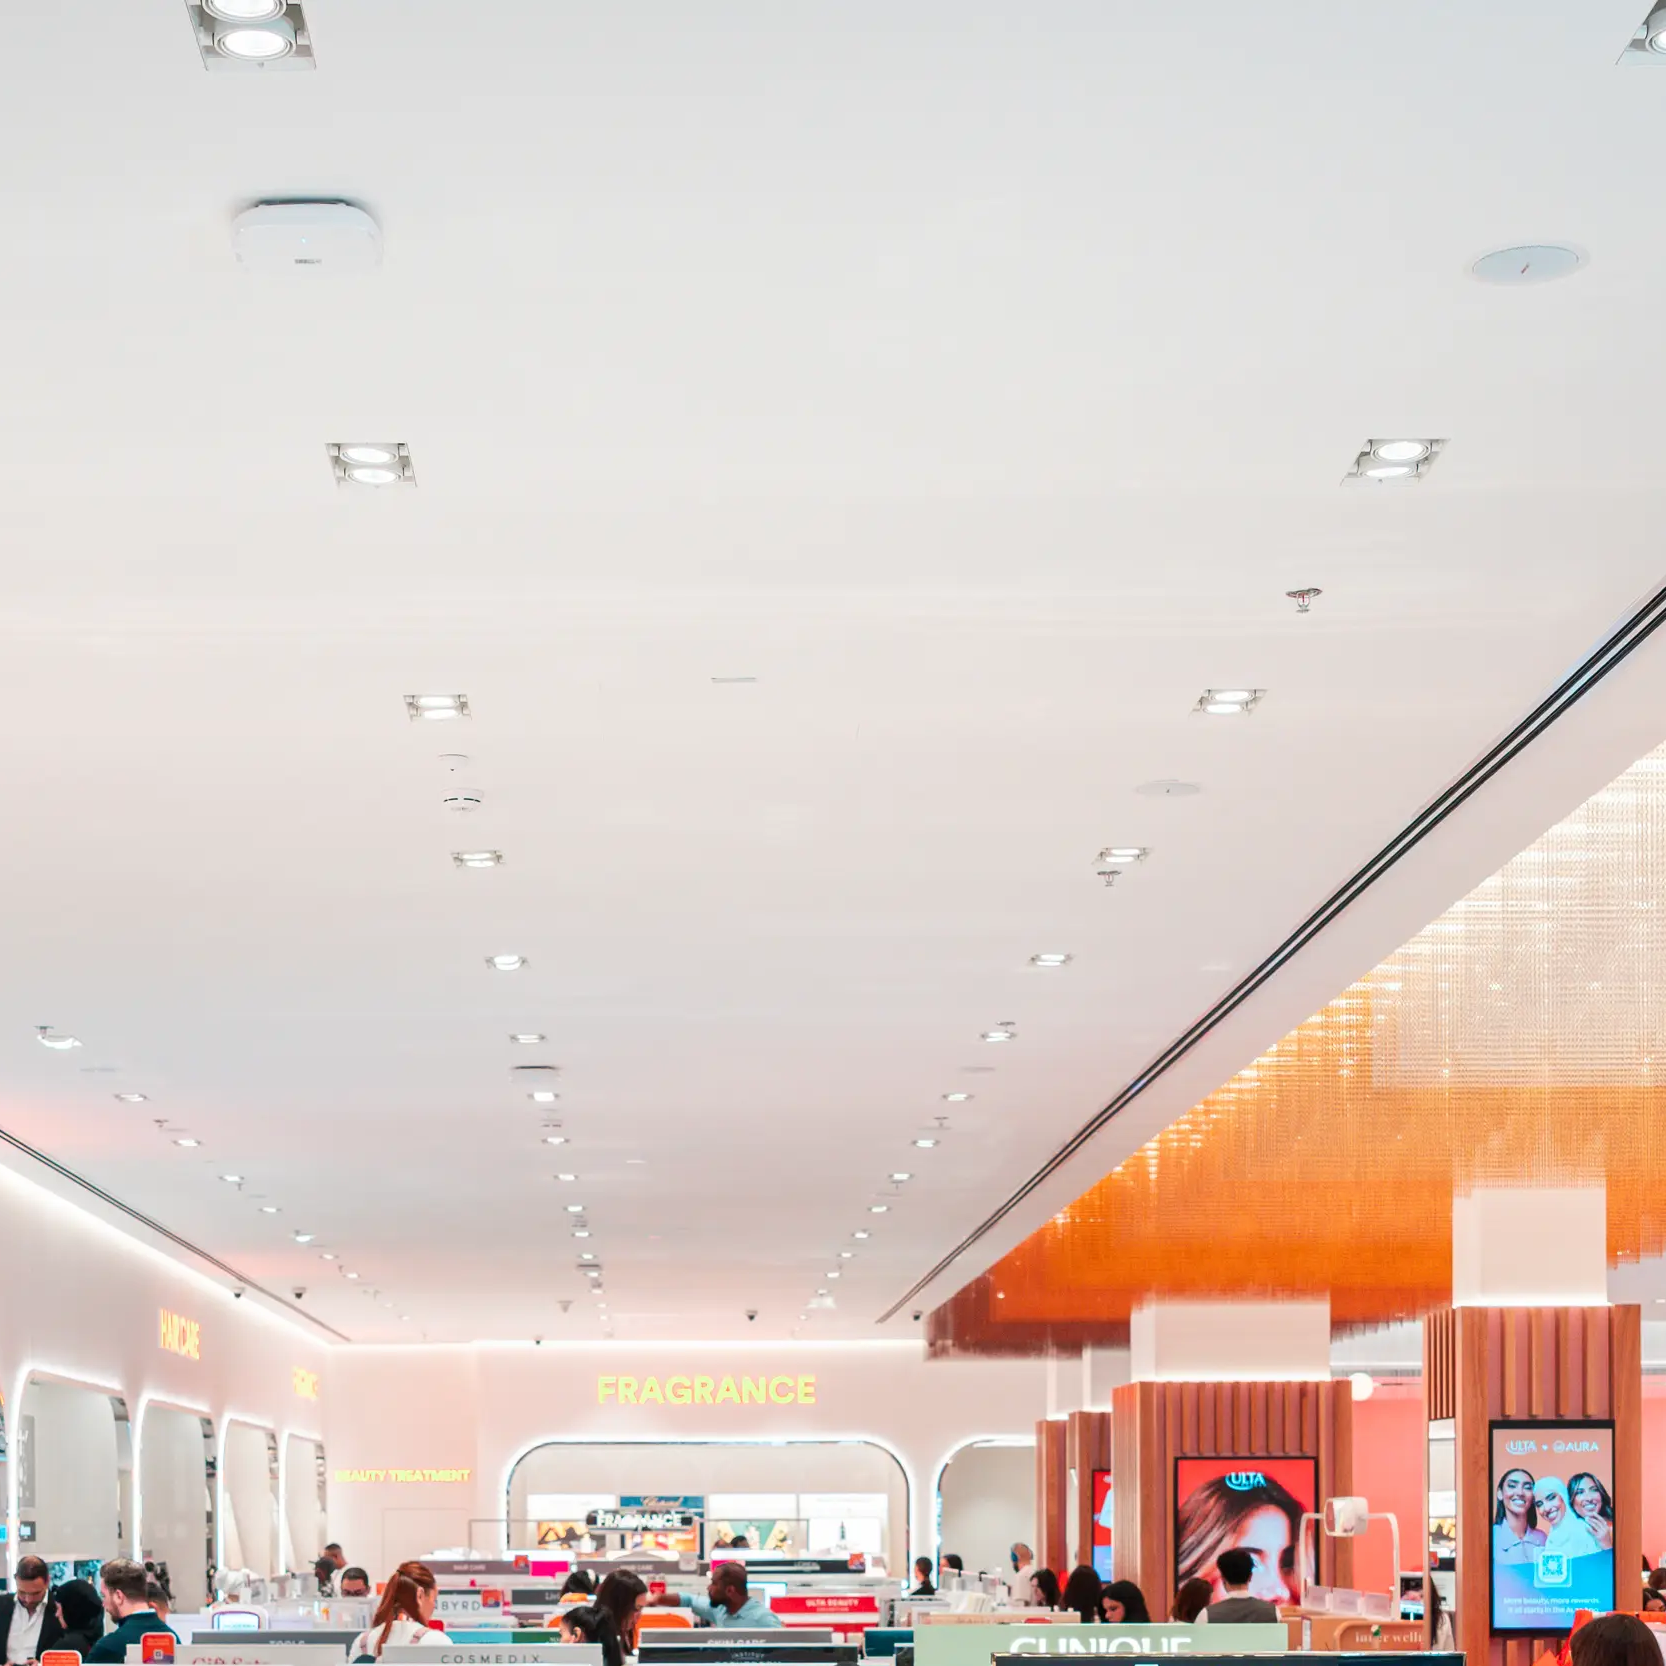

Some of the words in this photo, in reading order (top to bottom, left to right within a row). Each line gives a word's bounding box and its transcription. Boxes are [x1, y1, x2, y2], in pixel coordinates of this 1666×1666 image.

[160, 1309, 180, 1354] HAIR
[181, 1318, 200, 1360] CARE
[597, 1374, 815, 1404] FRAGRANCE
[1510, 1440, 1537, 1451] ULTA
[1566, 1441, 1599, 1452] AURA
[335, 1470, 387, 1483] BEAUTY
[390, 1469, 471, 1482] TREATMENT
[596, 1512, 682, 1529] FRAGRANCE
[806, 1598, 826, 1606] ULTA
[828, 1598, 859, 1607] BEAUTY
[441, 1655, 541, 1664] COSMEDIX
